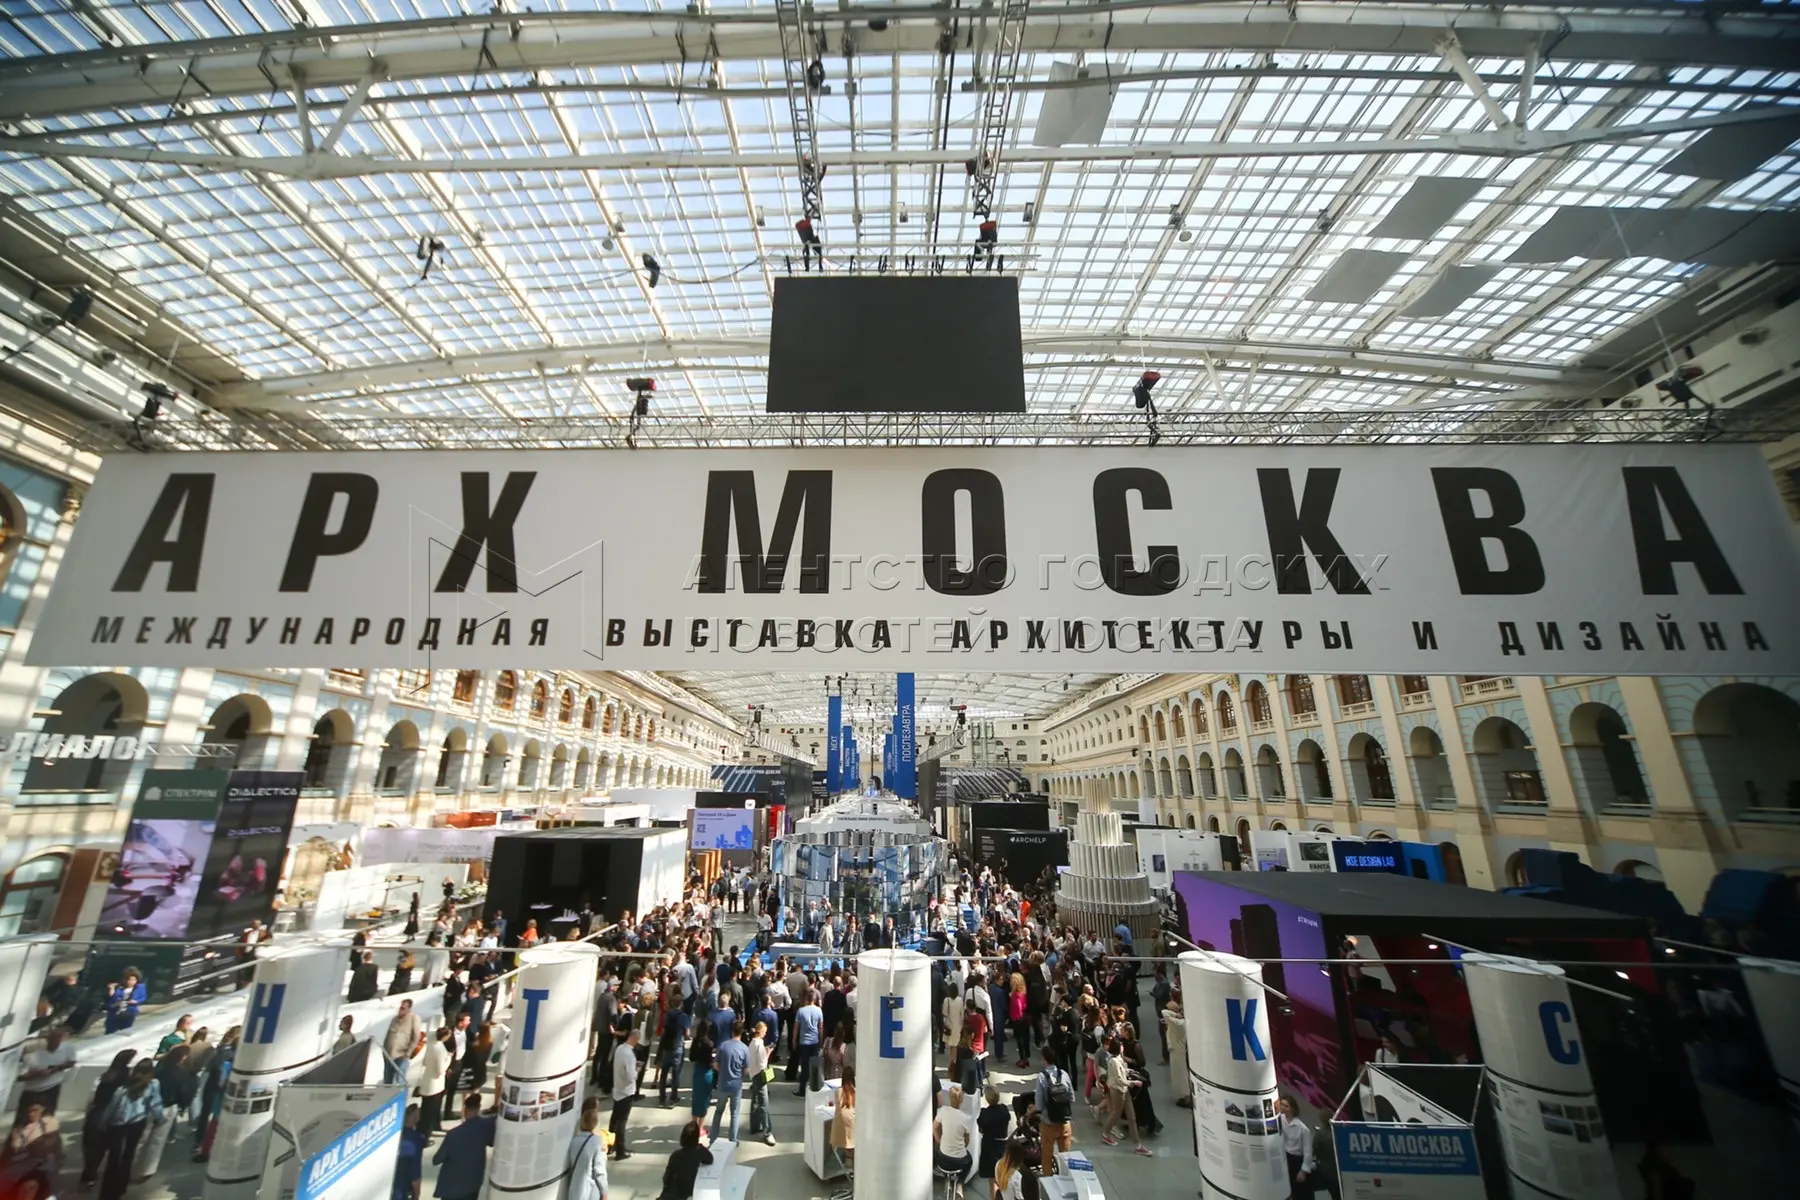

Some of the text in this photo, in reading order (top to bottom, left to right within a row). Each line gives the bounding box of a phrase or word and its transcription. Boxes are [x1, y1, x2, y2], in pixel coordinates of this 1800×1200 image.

[110, 466, 1746, 598] АРХ МОСКВА
[90, 612, 1772, 657] МЕЖДУНАРОДНАЯ ВЫСТАВКА АРХИТЕКТУРЫ И ДИЗАЙНА
[830, 735, 838, 751] NEXT
[901, 704, 911, 762] ПОСЛЕЗАВТРА
[1015, 836, 1047, 844] ARCHELP
[308, 1102, 399, 1185] АРХ МОСКВА
[1348, 1132, 1465, 1157] АРХ МОСКВА
